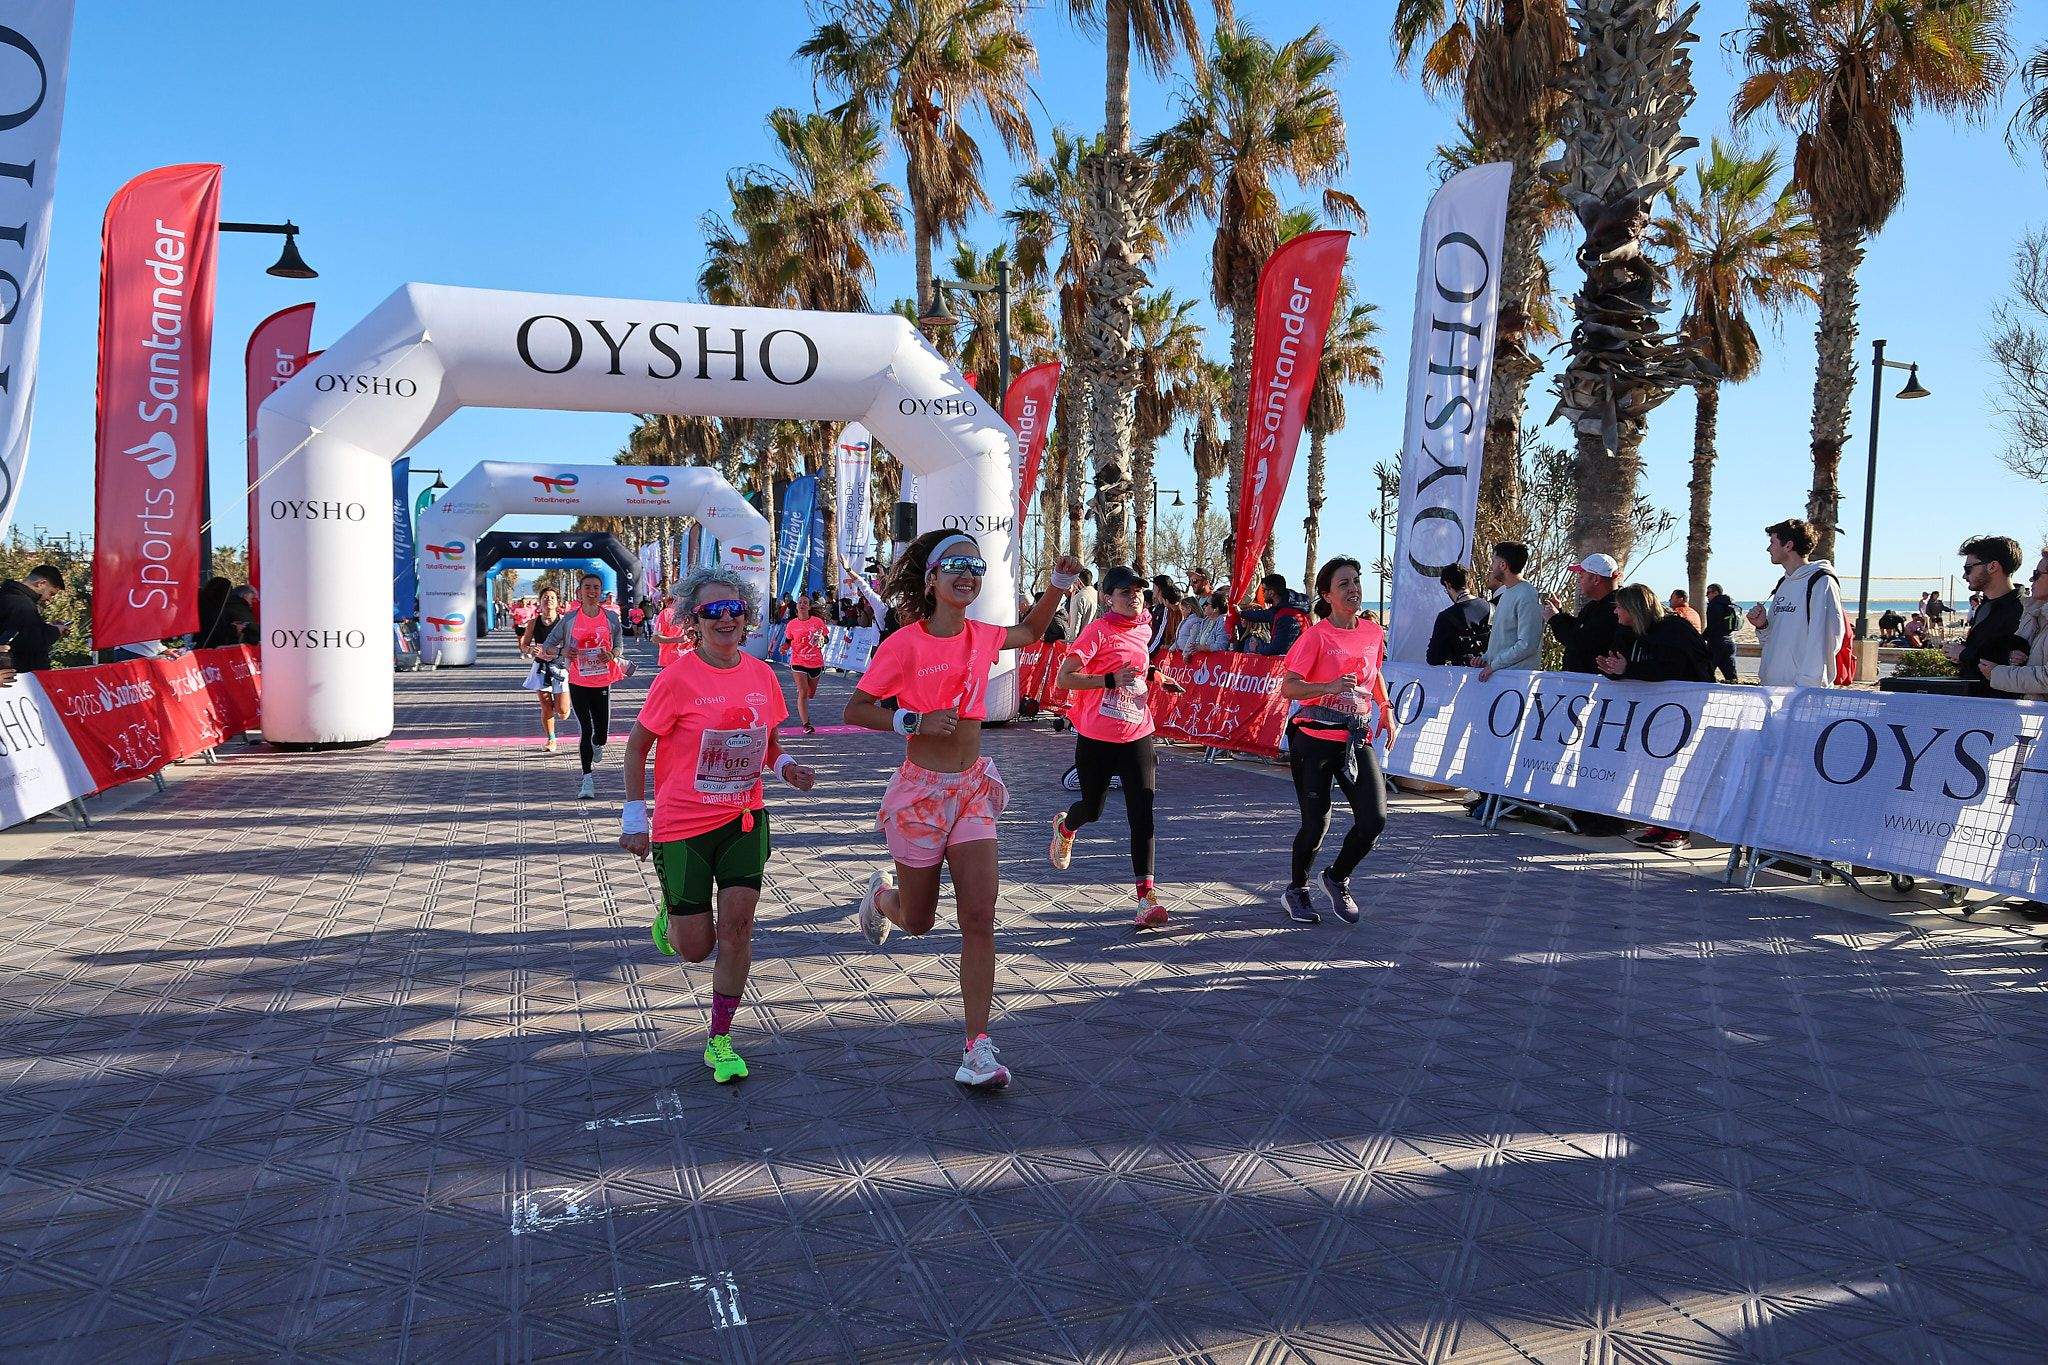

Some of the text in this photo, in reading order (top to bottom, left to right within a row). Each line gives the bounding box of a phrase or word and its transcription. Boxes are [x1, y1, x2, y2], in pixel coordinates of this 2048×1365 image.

[516, 314, 819, 386] OYSHO
[315, 373, 417, 398] OYSHO
[128, 218, 187, 611] Sports Santander
[899, 397, 977, 417] OYSHO
[1408, 231, 1489, 579] OYSHO
[270, 500, 366, 522] OYSHO
[534, 495, 580, 504] TotalEnergies
[942, 514, 1014, 532] OYSHO
[509, 541, 593, 549] VOLVO
[270, 629, 366, 650] OYSHO
[917, 663, 949, 677] OYSHO
[1209, 664, 1284, 694] Santander
[694, 695, 726, 706] OYSHO
[1488, 689, 1692, 759] OYSHO
[1522, 757, 1616, 782] WWW.OYSHO.COM
[1813, 718, 2048, 807] OYSH
